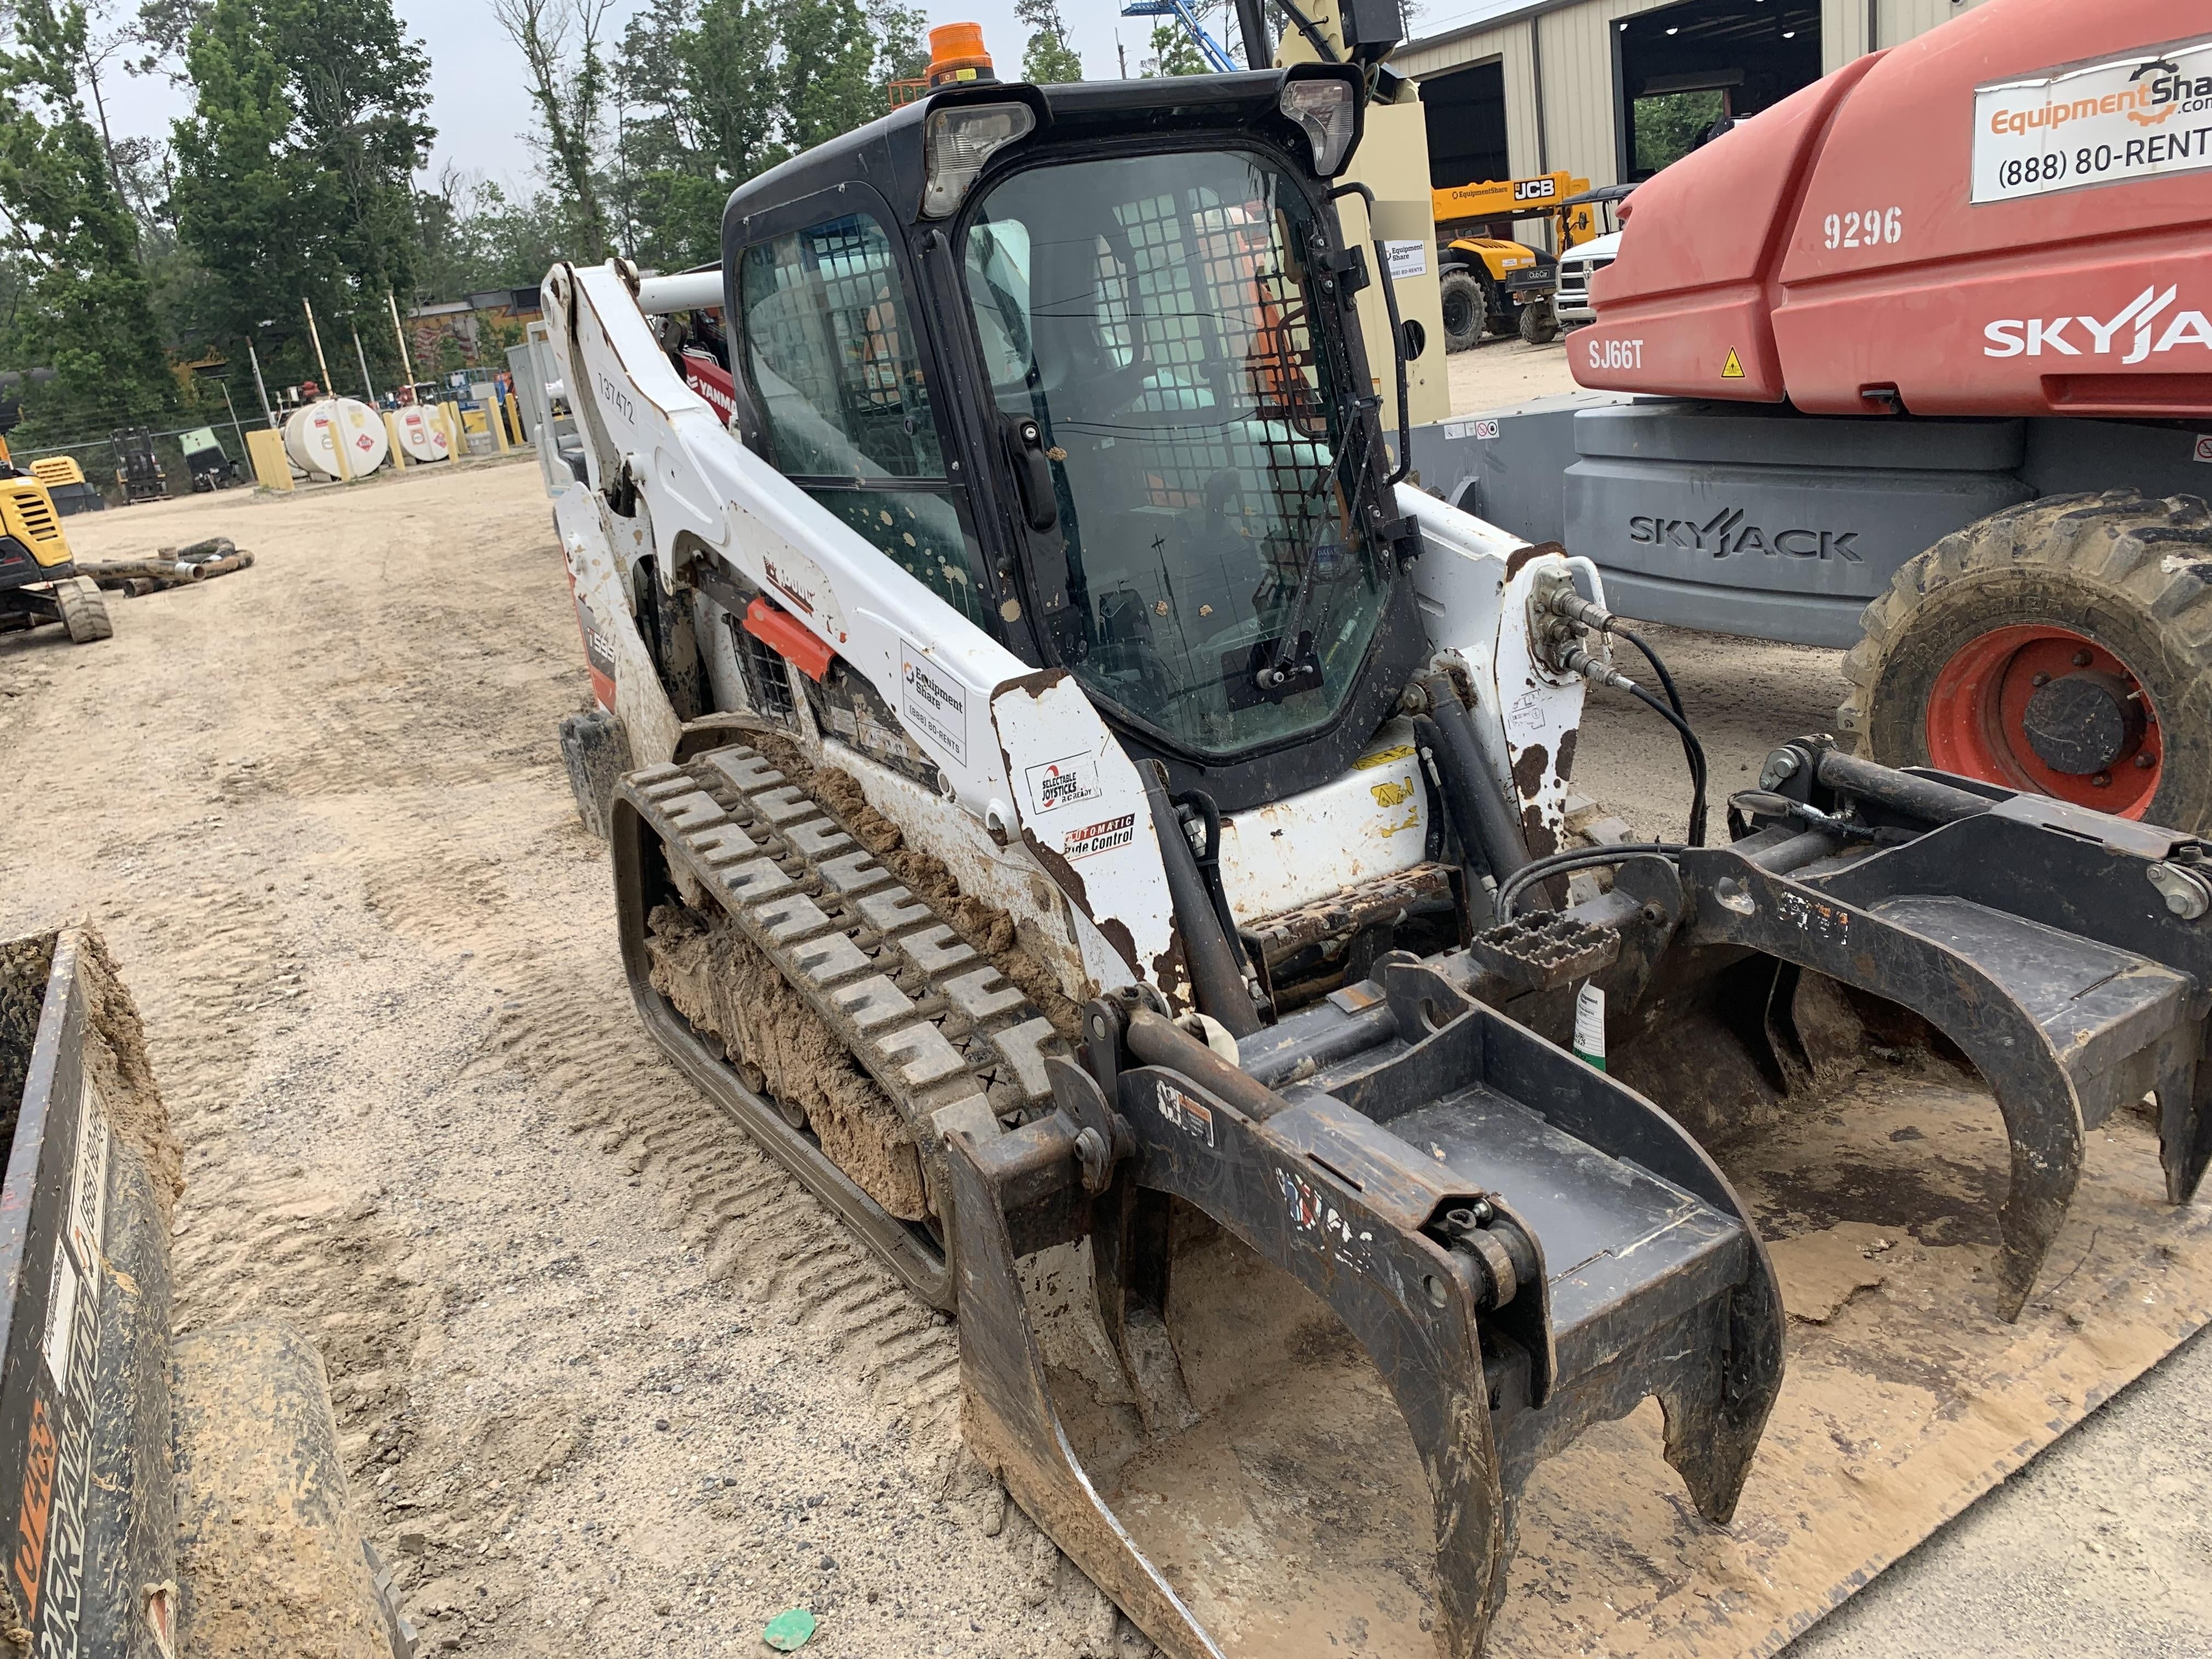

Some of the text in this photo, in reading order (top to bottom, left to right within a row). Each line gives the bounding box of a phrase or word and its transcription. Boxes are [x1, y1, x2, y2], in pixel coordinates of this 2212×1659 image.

[1999, 150, 2067, 189] (888)
[1459, 179, 1555, 200] EquipmentShare JCB
[1824, 206, 1903, 249] 9296
[1392, 244, 1423, 255] Equipment
[1401, 267, 1423, 275] 80-RENTS
[1589, 340, 1644, 369] SJ66T
[599, 373, 634, 425] 137472
[1629, 507, 1864, 563] SKYJACK
[916, 681, 941, 710] Share
[910, 704, 927, 726] (888)
[928, 721, 960, 754] 80-RENTS
[1042, 772, 1076, 789] SELECTABLE
[1042, 781, 1076, 802] JOYSTICKS
[1073, 788, 1092, 799] READY
[1067, 816, 1132, 842] AUTOMATIC
[1091, 827, 1133, 851] Control
[41, 1274, 101, 1659] ARRYALL 1700
